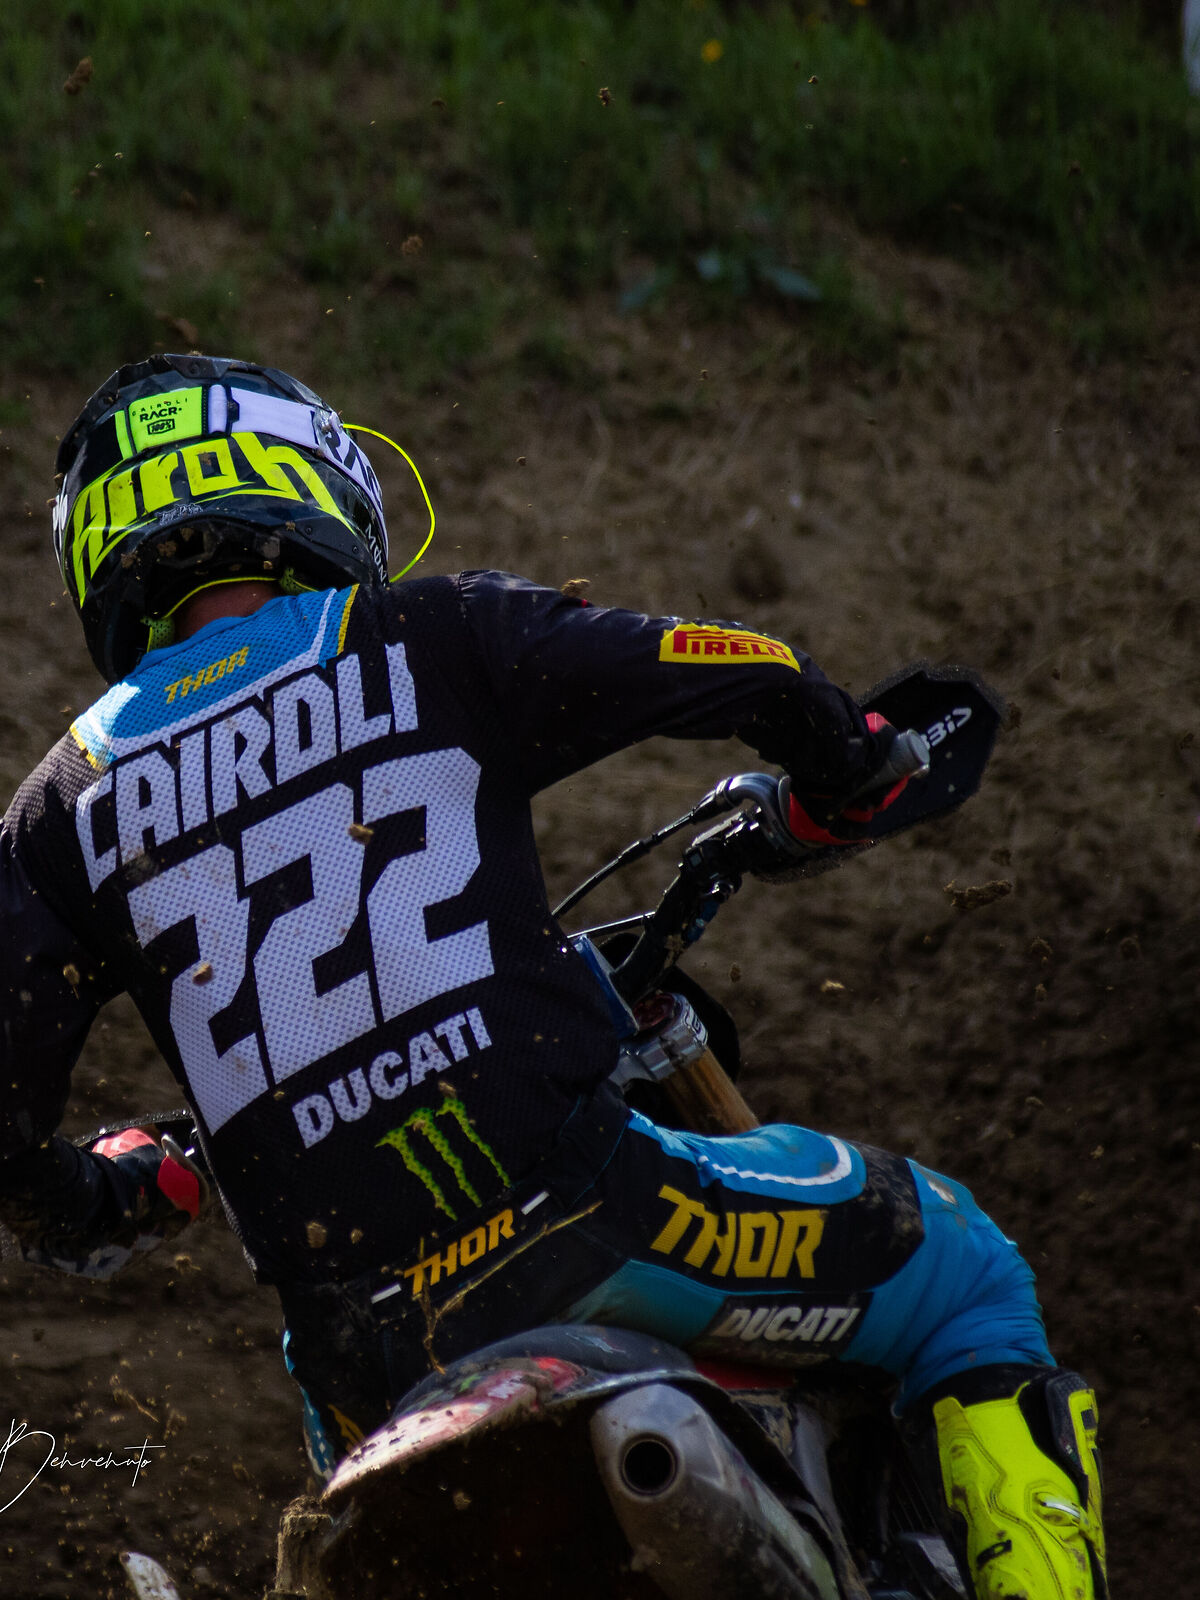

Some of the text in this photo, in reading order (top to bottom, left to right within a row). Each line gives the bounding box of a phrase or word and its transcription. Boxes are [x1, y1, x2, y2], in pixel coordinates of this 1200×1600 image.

[164, 646, 250, 704] THOR
[672, 625, 791, 662] PIRELLI
[75, 642, 418, 893] CAIROLI
[127, 747, 495, 1137] 222
[291, 1006, 493, 1149] DUCATI
[404, 1208, 516, 1301] THOR
[651, 1184, 830, 1279] THOR
[710, 1306, 861, 1342] DUCATI
